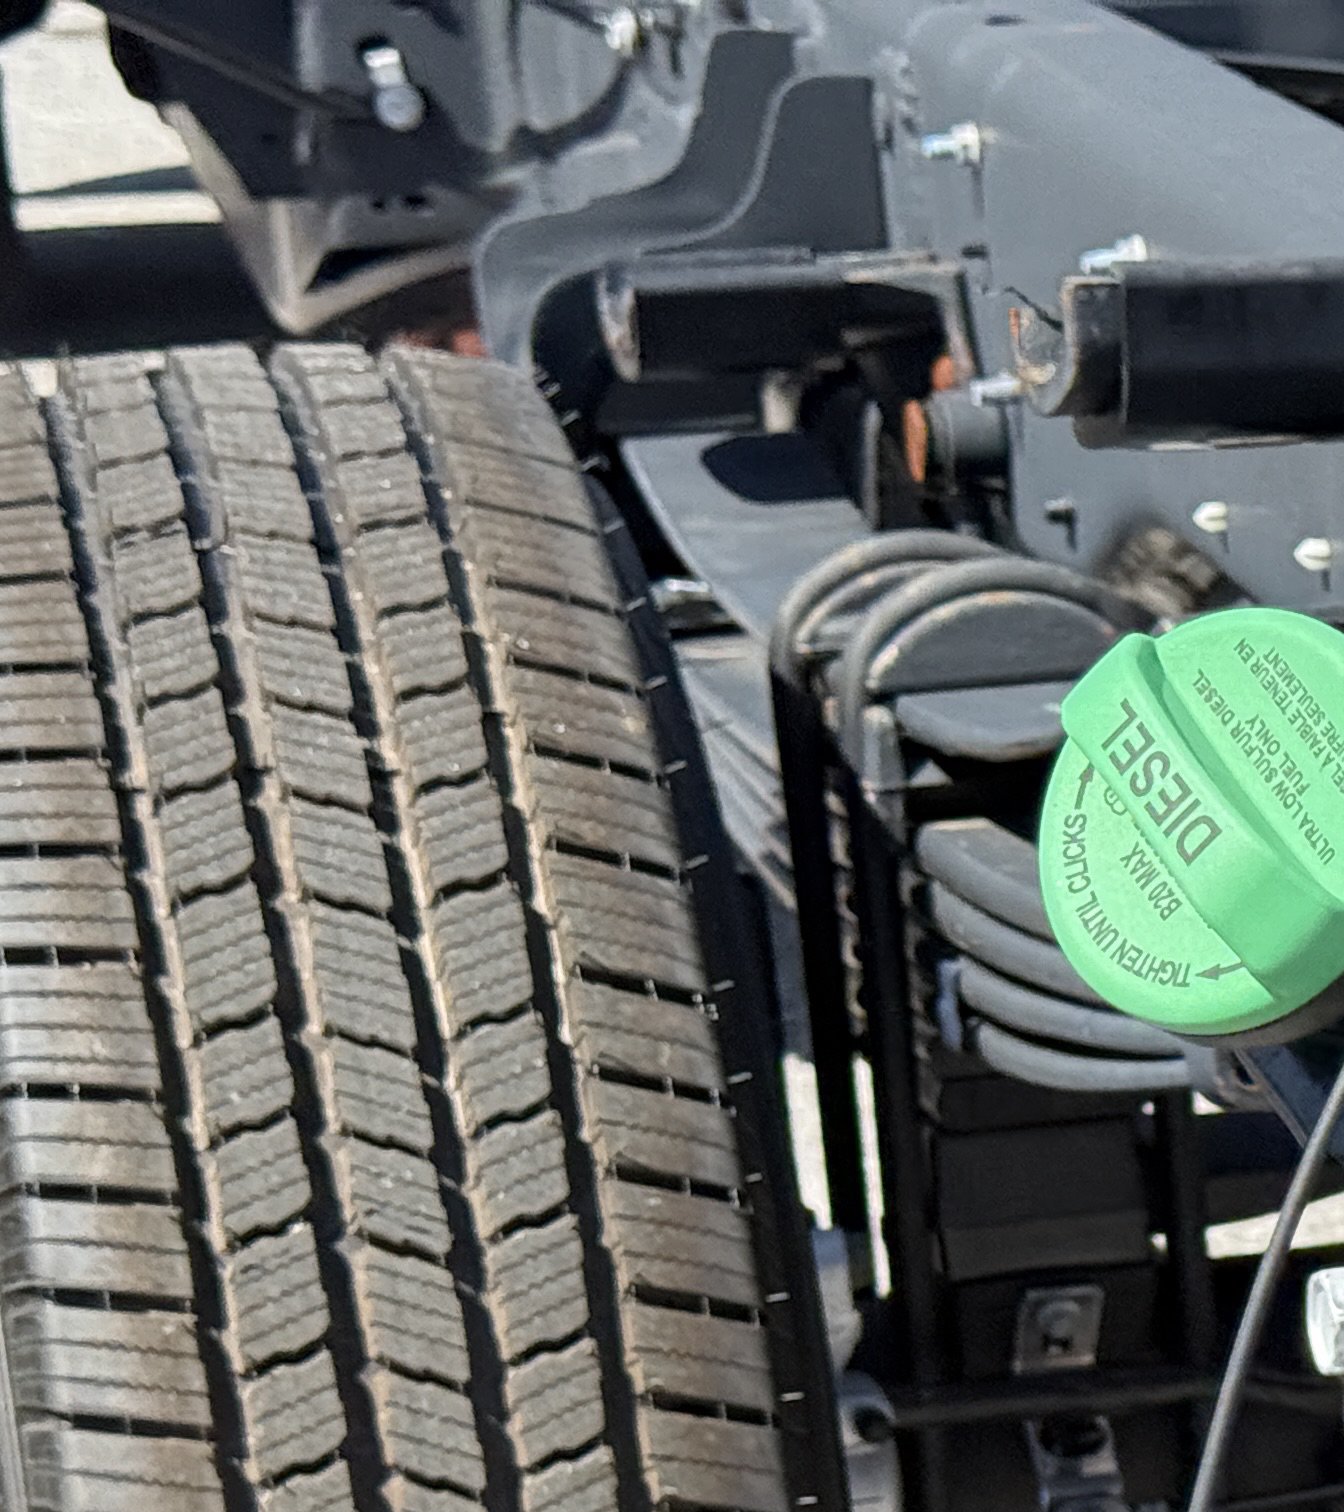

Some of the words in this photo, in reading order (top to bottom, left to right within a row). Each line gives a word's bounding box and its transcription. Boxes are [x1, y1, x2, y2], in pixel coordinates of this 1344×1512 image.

[1234, 638, 1255, 664] EN
[1192, 668, 1235, 726] DIESEL
[1250, 657, 1293, 715] TENEUR
[1263, 646, 1326, 725] SEULEMENT
[1230, 720, 1278, 783] SULFUR
[1245, 713, 1280, 756] ONLY
[1288, 708, 1326, 758] FAIBLE
[1101, 697, 1223, 866] DIESEL
[1272, 780, 1303, 819] LOW
[1279, 752, 1310, 796] FUEL
[1062, 813, 1091, 893] CLICKS
[1299, 812, 1335, 865] ULTRA
[1120, 841, 1157, 891] MAX
[1075, 890, 1120, 951] UNTIL
[1148, 881, 1183, 921] B20
[1110, 938, 1191, 987] TIGHTEN
